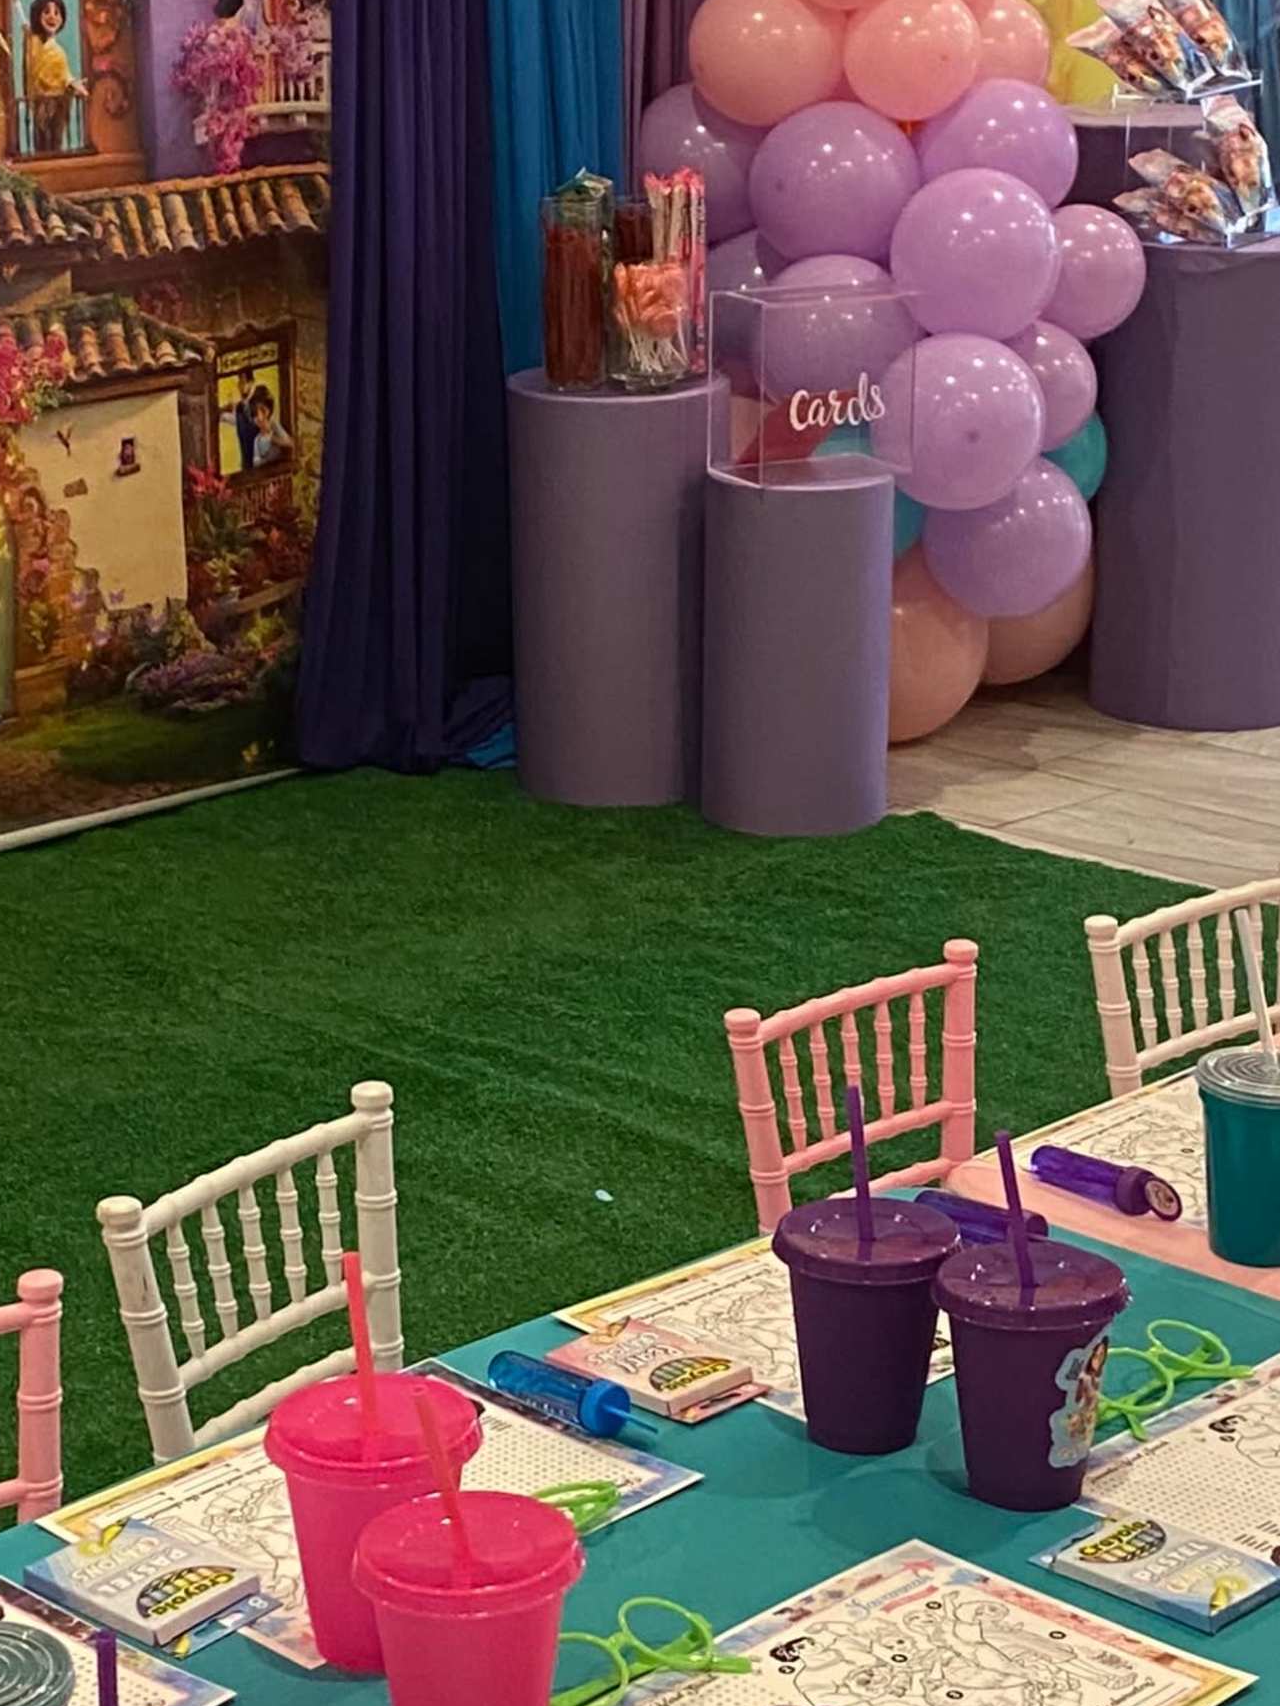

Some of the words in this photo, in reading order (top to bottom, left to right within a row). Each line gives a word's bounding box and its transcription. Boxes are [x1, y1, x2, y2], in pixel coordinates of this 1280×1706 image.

[789, 371, 886, 432] Cards
[1078, 1519, 1148, 1557] Crayola
[96, 1546, 190, 1595] PASTEL
[1129, 1541, 1211, 1584] PASTEL
[151, 1573, 235, 1618] Crayola
